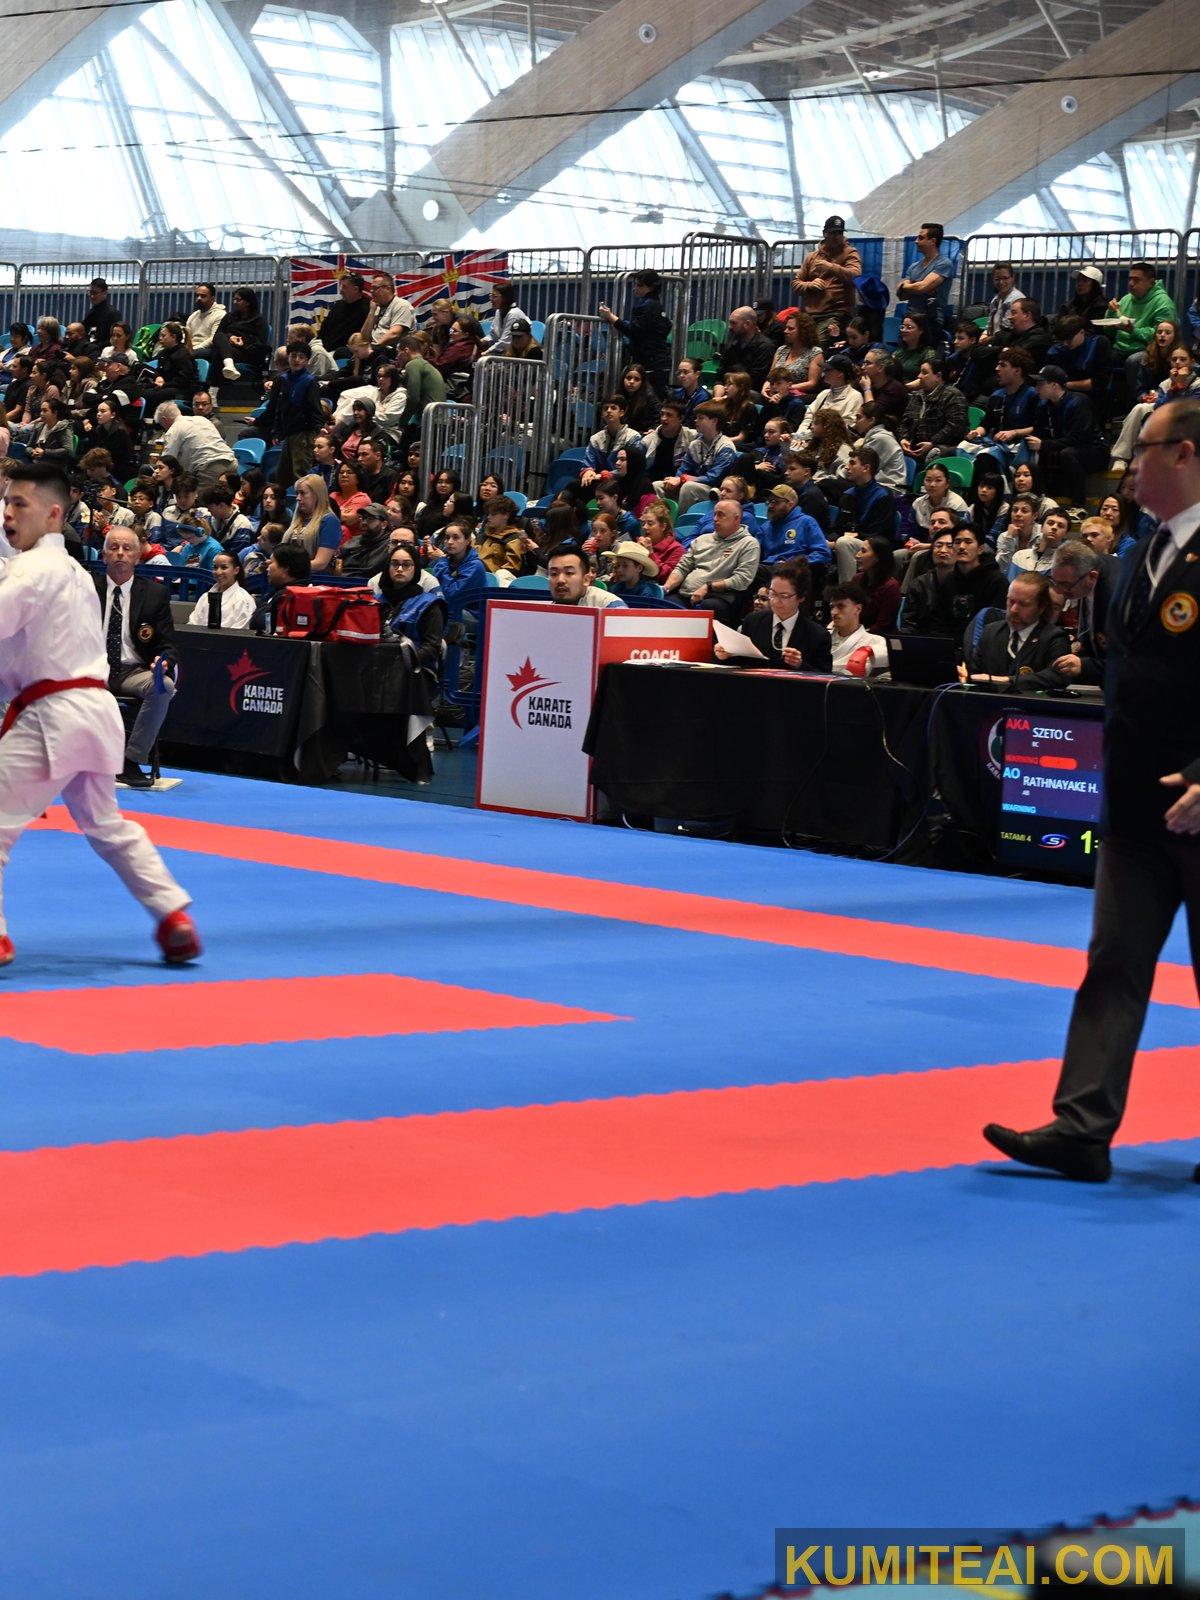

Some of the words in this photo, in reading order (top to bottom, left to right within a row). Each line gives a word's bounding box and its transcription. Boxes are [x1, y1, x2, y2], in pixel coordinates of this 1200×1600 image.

[630, 649, 680, 660] COACH
[243, 684, 284, 701] KARATE
[242, 698, 283, 714] CANADA
[529, 696, 572, 713] KARATE
[528, 712, 572, 730] CANADA
[1006, 718, 1030, 731] AKA
[1032, 727, 1062, 740] SZETO
[1003, 767, 1021, 779] AO
[1023, 776, 1087, 793] RATHNAYAKE
[1002, 803, 1037, 814] WARNING
[1000, 831, 1026, 841] TATAMI
